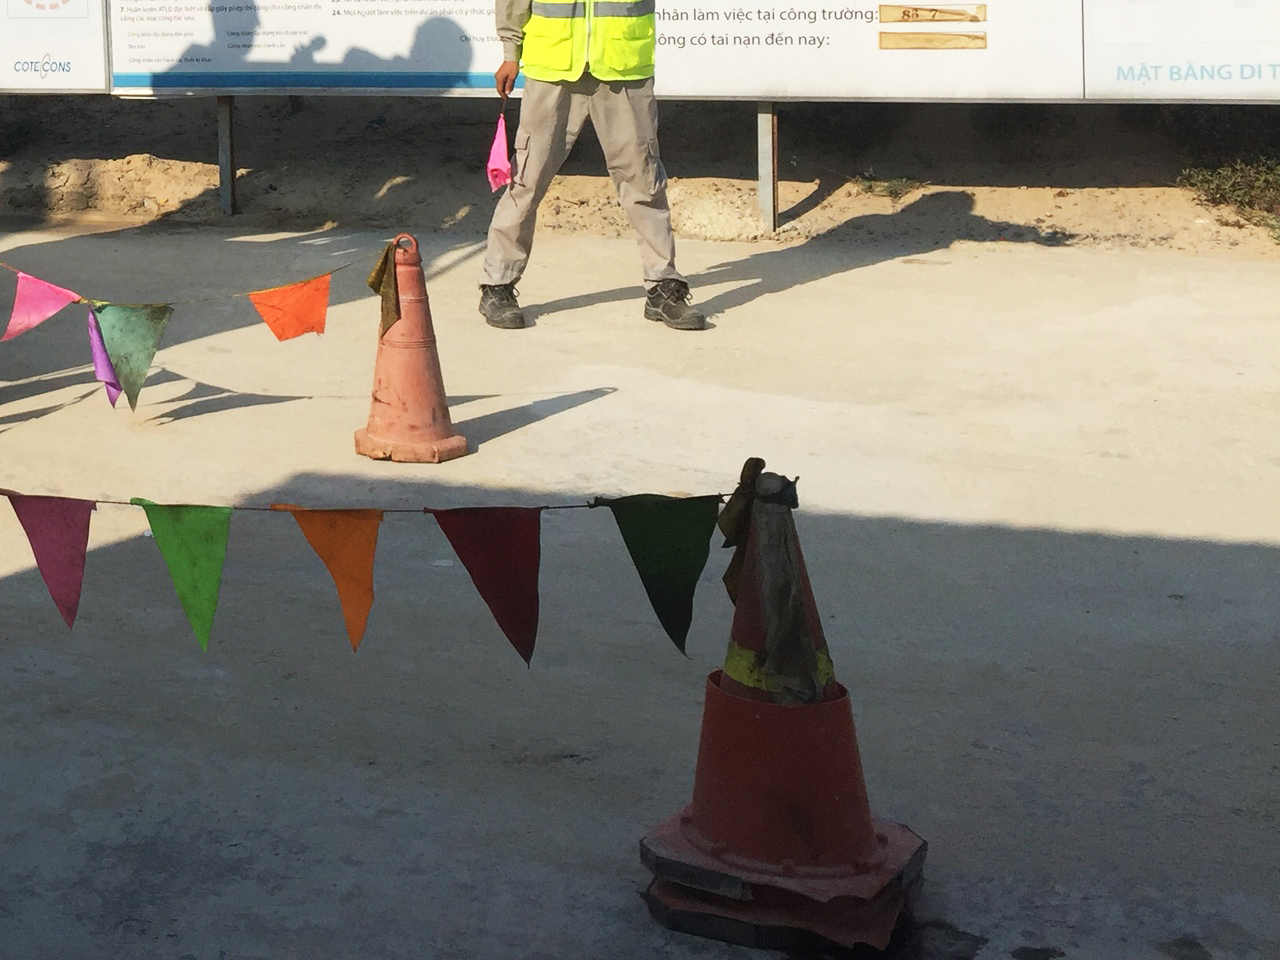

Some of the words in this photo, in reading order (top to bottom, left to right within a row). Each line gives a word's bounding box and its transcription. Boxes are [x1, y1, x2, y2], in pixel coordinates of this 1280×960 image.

[693, 8, 720, 21] làm
[723, 9, 753, 24] việc
[757, 8, 775, 24] tại
[780, 8, 818, 24] công
[821, 8, 879, 24] trường:
[690, 33, 707, 46] có
[711, 33, 728, 46] tai
[733, 35, 761, 49] nạn
[765, 31, 794, 46] đến
[798, 35, 830, 48] nay:
[1240, 63, 1262, 80] DI
